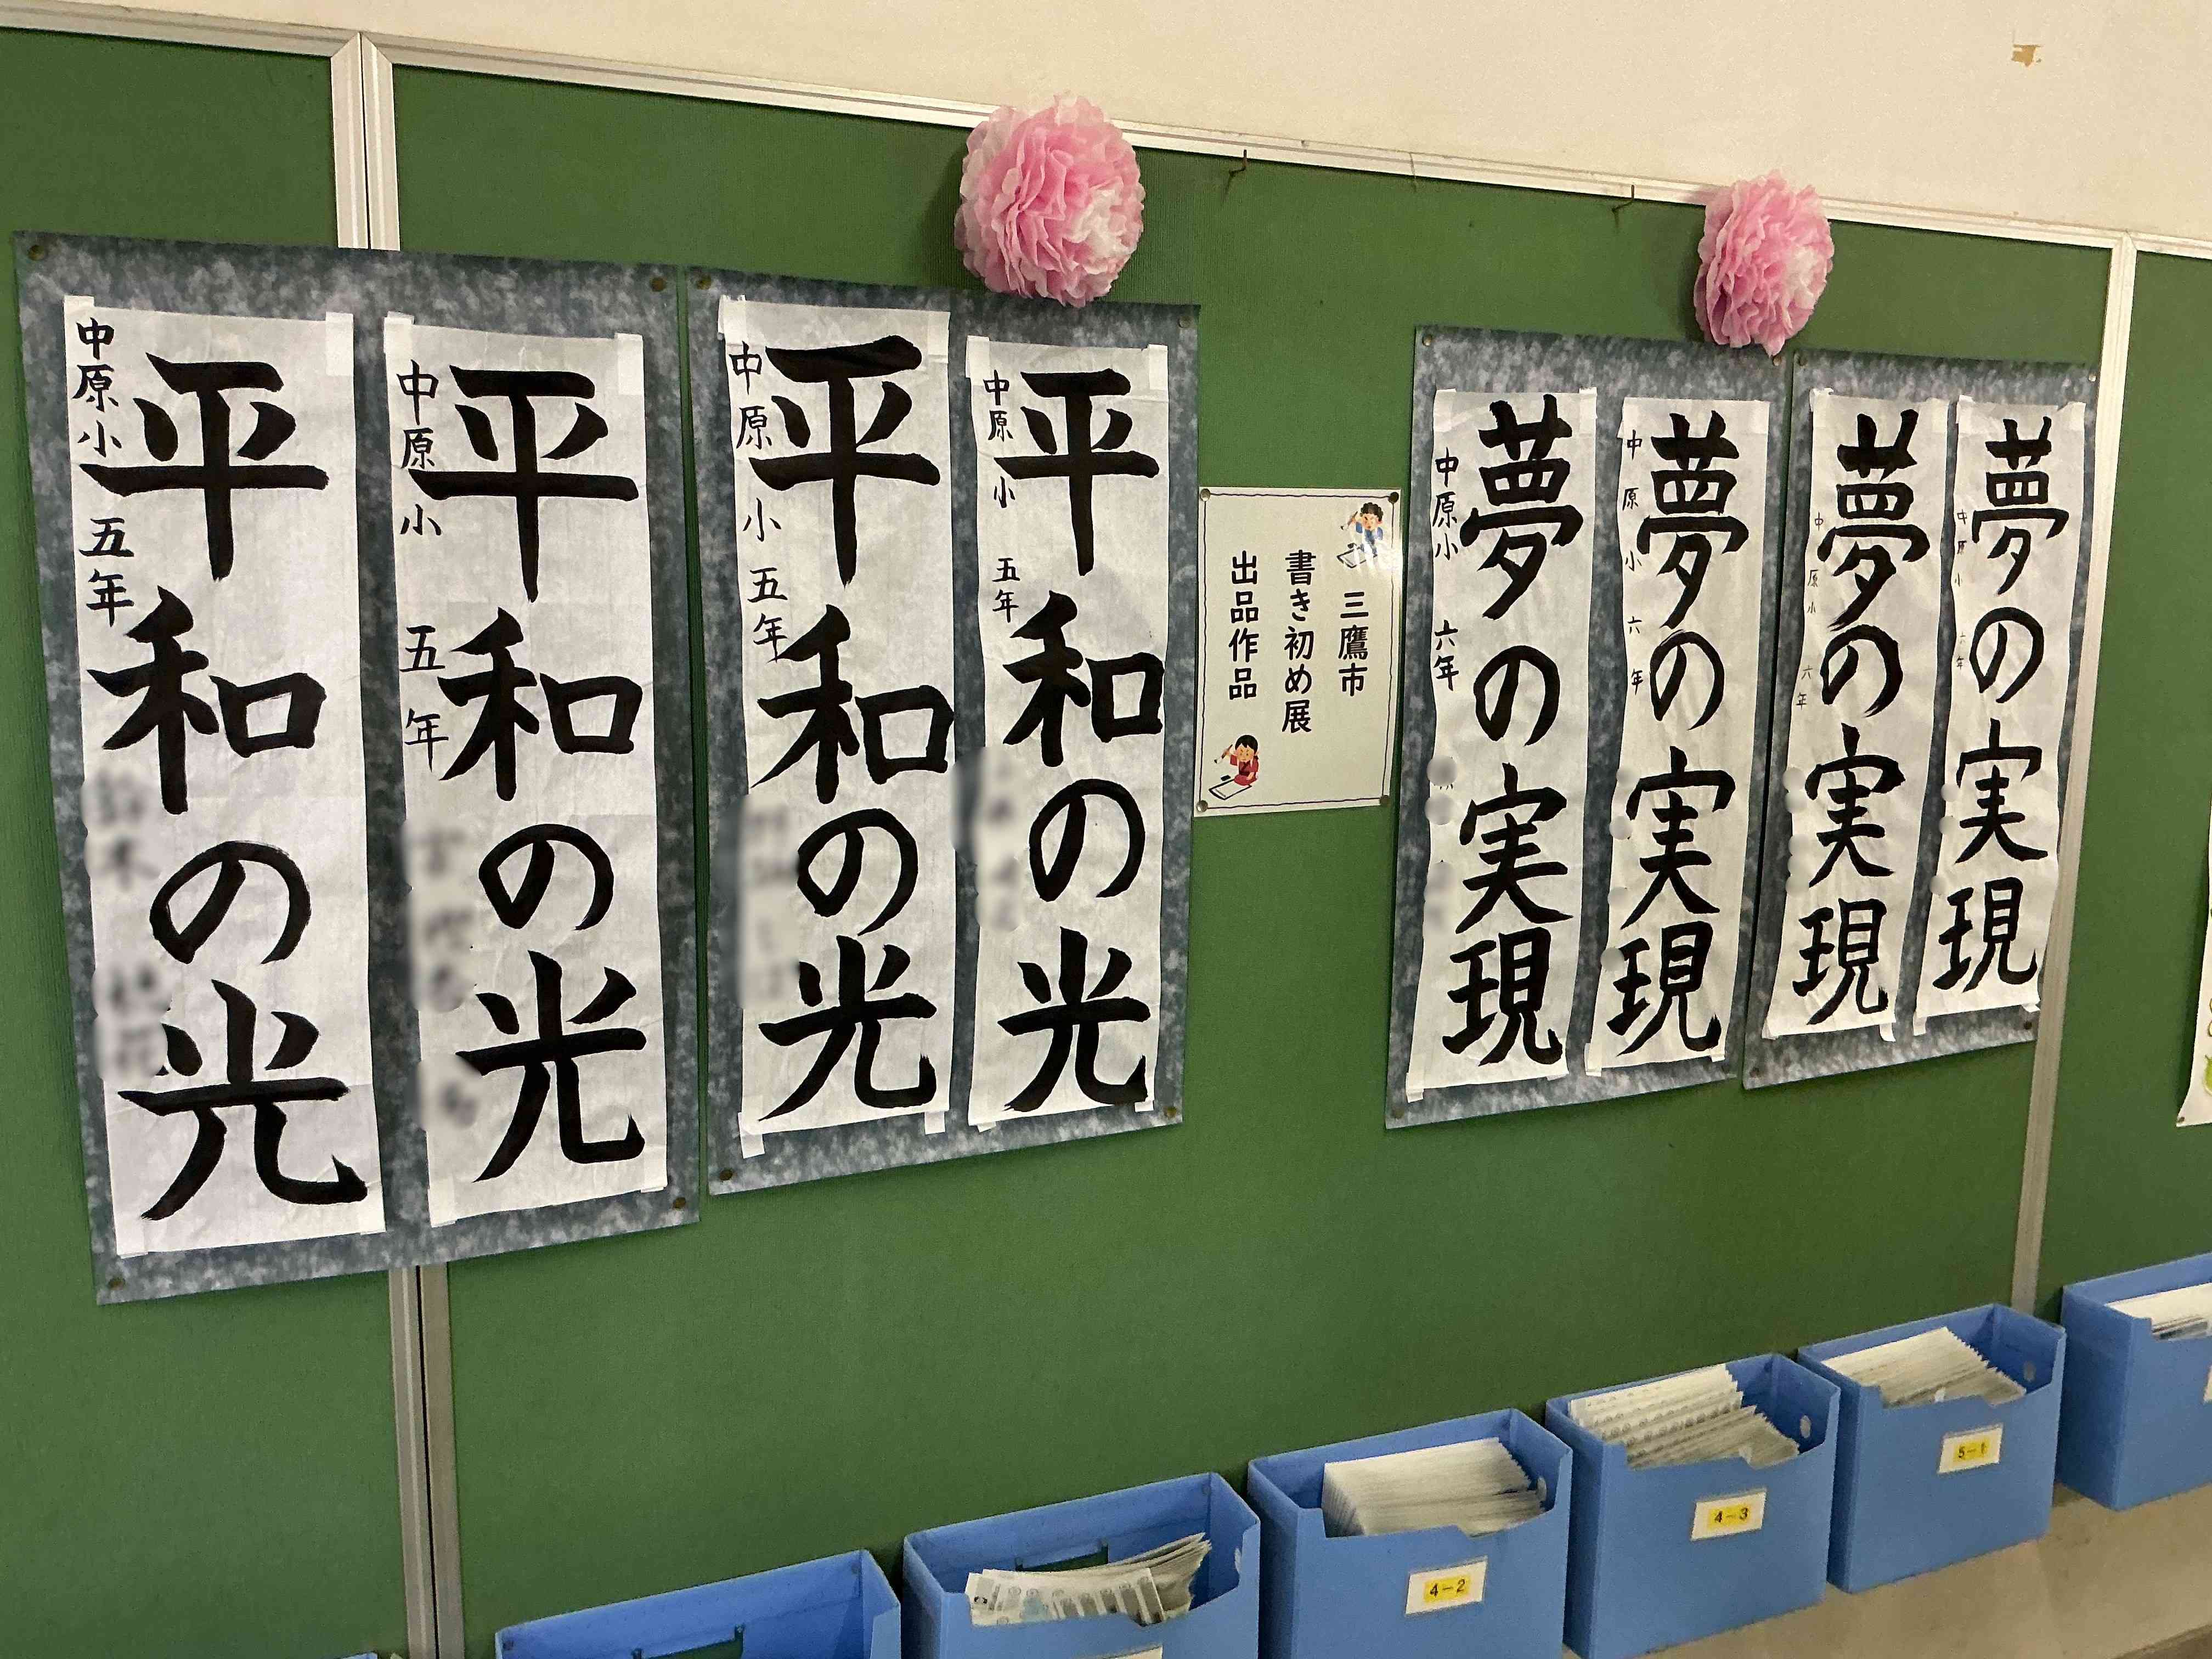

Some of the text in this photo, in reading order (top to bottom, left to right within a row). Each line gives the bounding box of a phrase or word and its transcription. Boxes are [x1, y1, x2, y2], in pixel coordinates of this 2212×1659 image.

[71, 317, 135, 627] 中原小 五年
[397, 359, 442, 536] 中原小
[729, 341, 788, 663] 中原小 五年
[983, 370, 1021, 623] 中原小 五年
[1432, 447, 1459, 691] 中原小 六年
[400, 625, 449, 772] 五年
[408, 365, 646, 1183] 平和の光
[749, 335, 956, 1121] 平和の光
[993, 368, 1165, 1112] 平和の光
[1228, 550, 1260, 700] 出品作品
[1282, 549, 1316, 733] 書き初め展
[1338, 591, 1369, 697] 三鷹市
[1442, 394, 1584, 1066] 夢の実現
[1606, 410, 1749, 1057] 夢の実現
[1792, 408, 1930, 1025] 夢の実現
[1933, 416, 2069, 993] 夢の実現
[79, 353, 368, 1220] 平和の光
